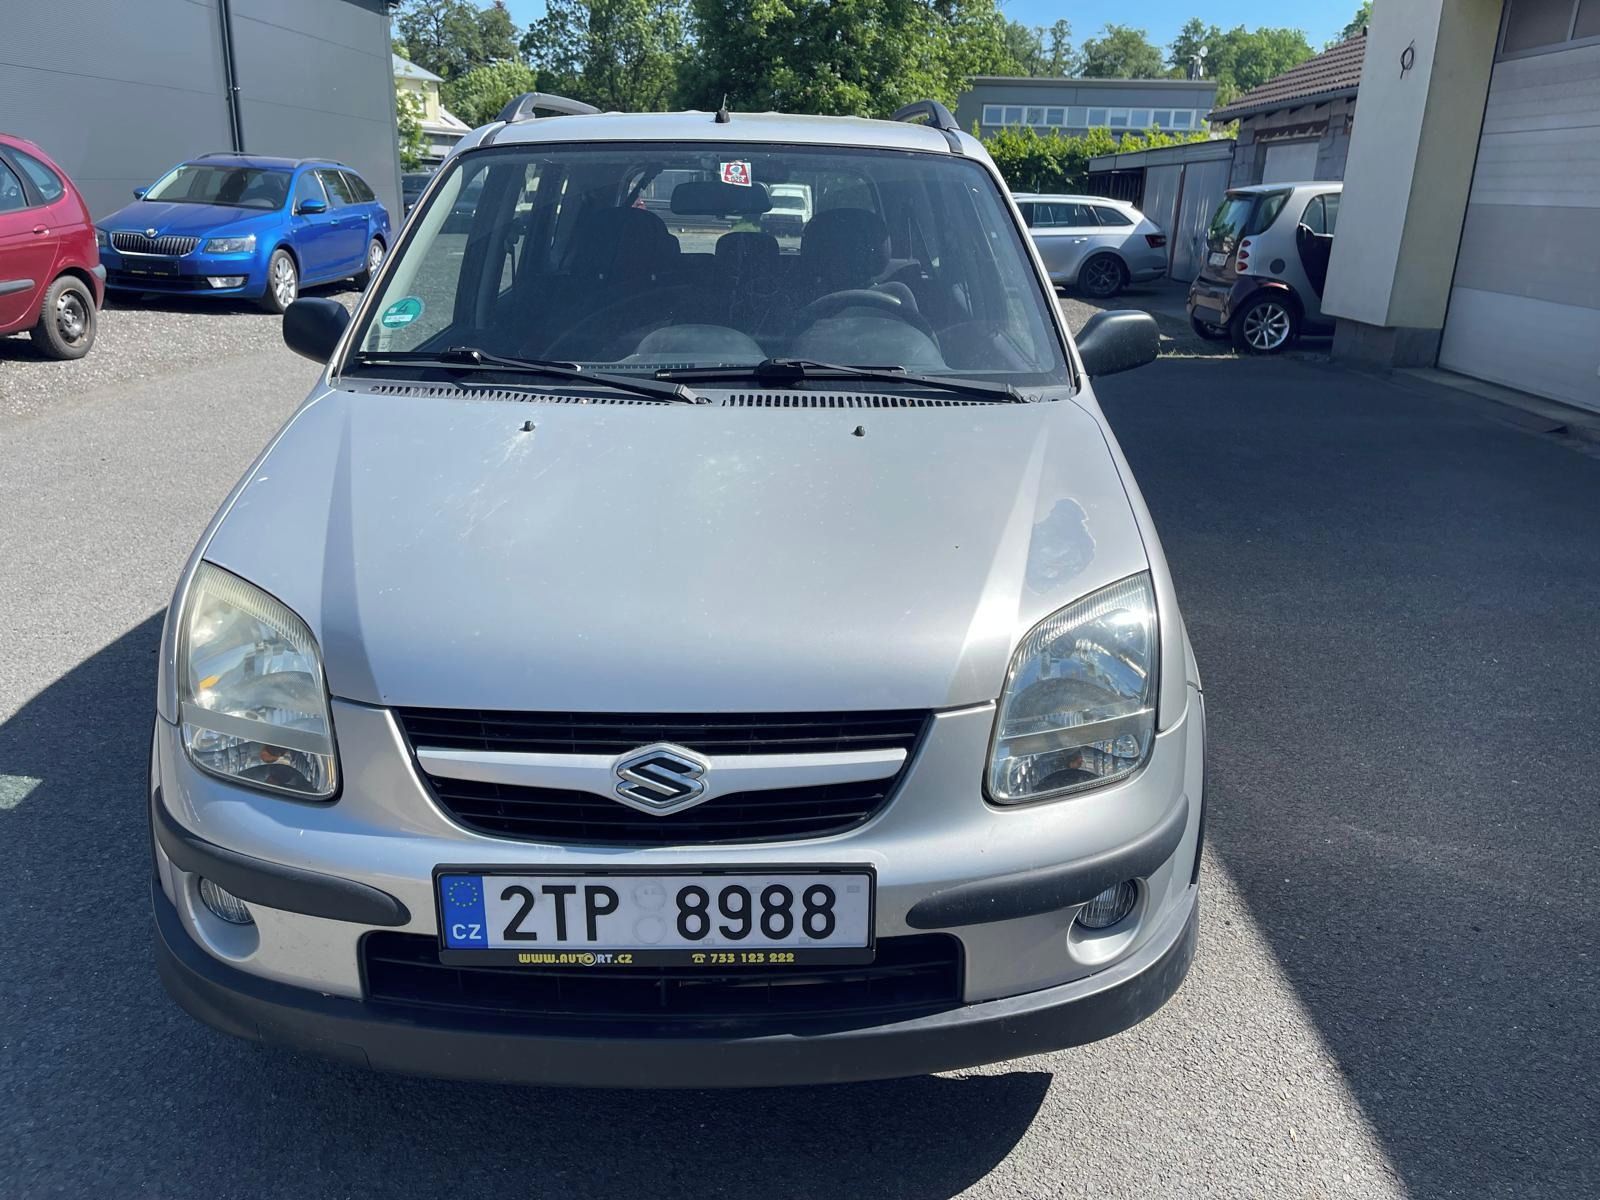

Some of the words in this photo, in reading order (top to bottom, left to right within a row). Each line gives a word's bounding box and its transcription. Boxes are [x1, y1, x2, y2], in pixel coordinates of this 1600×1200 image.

[500, 885, 620, 941] 2TP
[676, 884, 836, 941] 8988
[452, 924, 482, 940] CZ
[710, 953, 736, 963] 733
[741, 953, 765, 963] 123
[769, 952, 795, 963] 222
